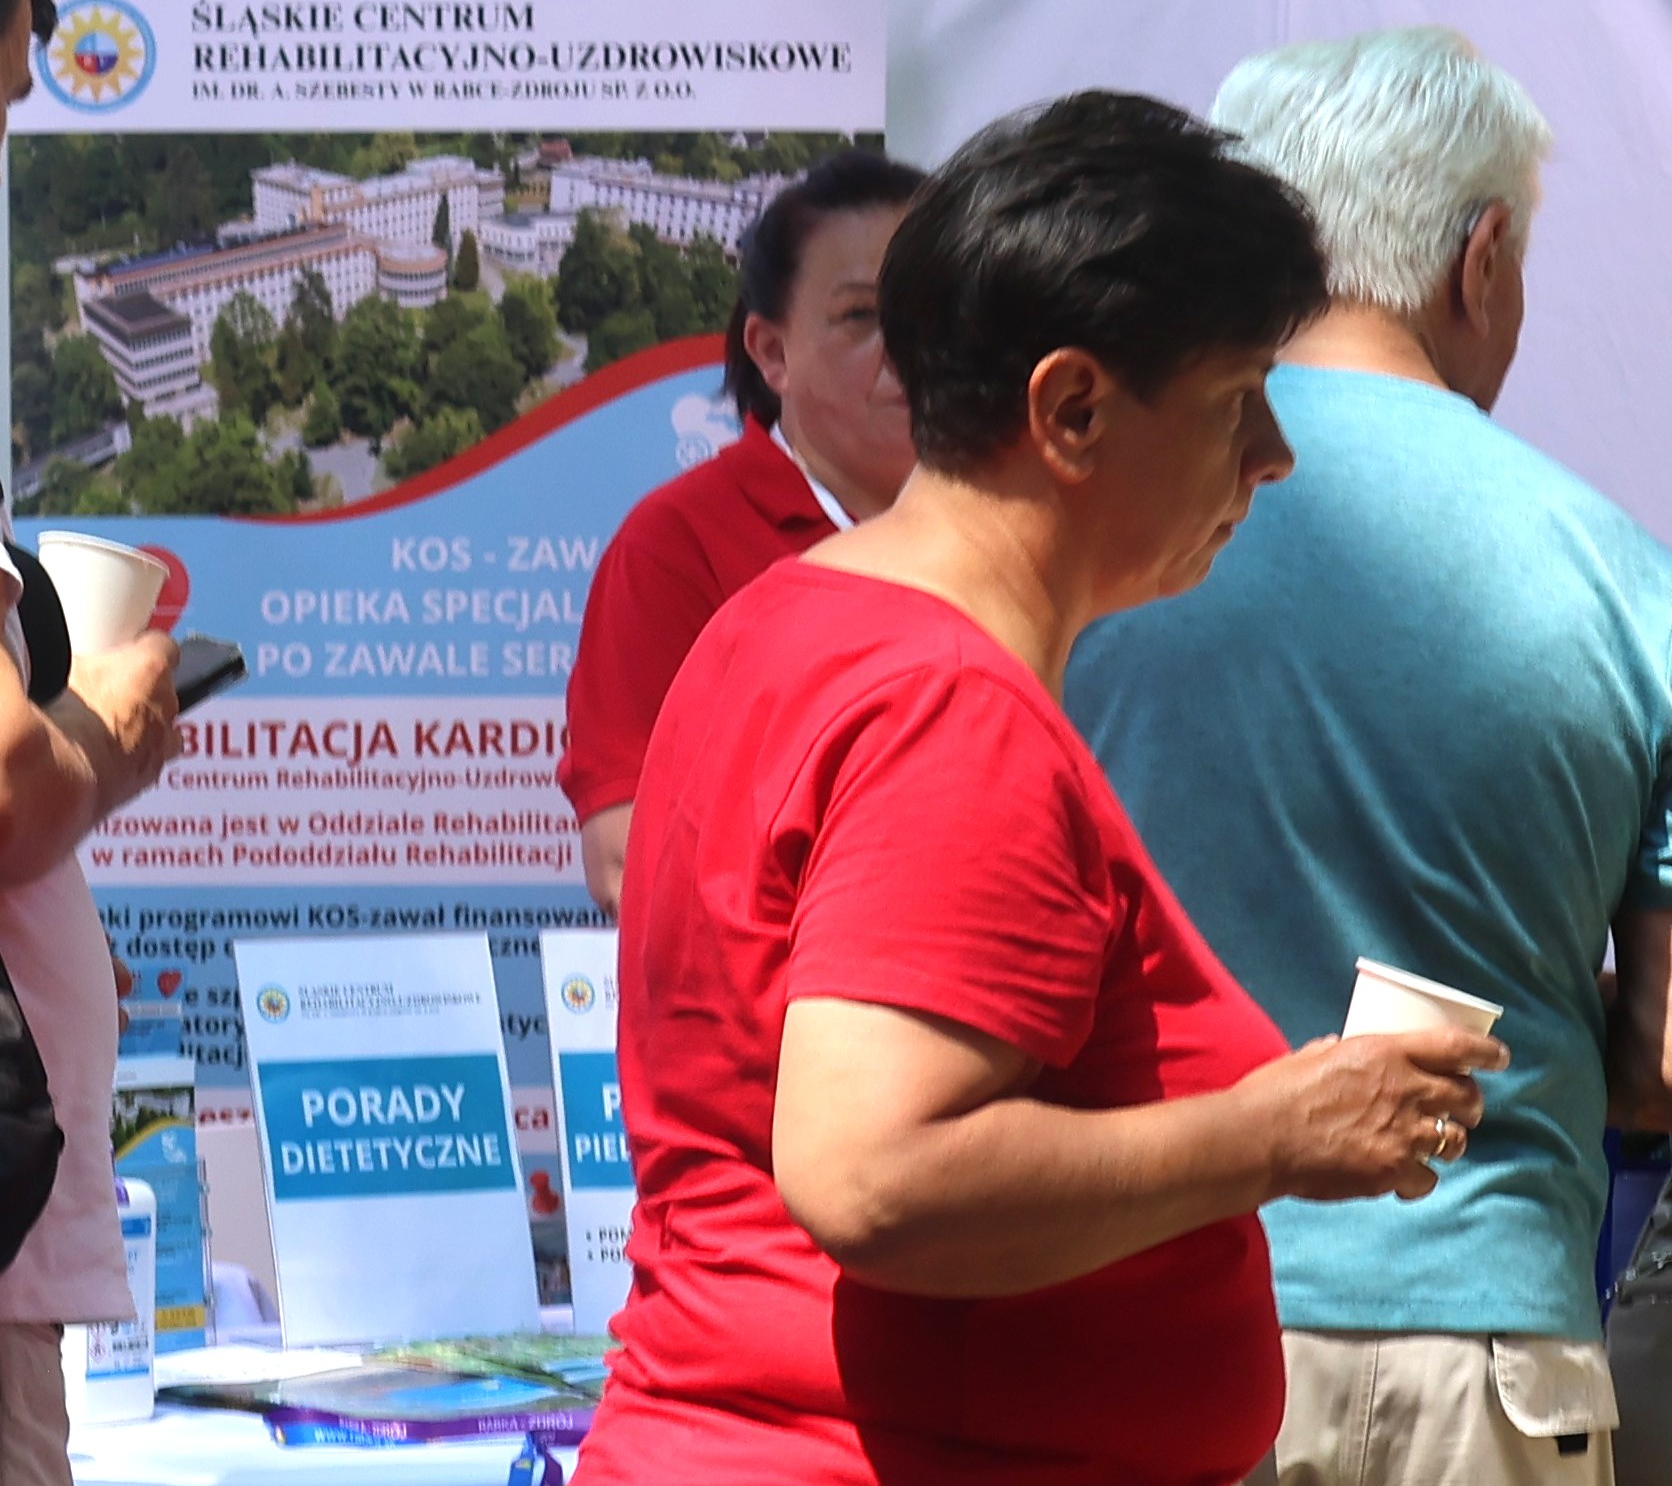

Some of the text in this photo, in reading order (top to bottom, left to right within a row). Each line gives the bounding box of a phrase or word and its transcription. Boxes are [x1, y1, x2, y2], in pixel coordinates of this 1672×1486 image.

[353, 2, 534, 33] CENTRUM
[192, 41, 852, 73] REHABILITACYJNO-UZDROWISKOWE
[391, 537, 472, 572] KOS
[506, 537, 599, 572] ZAW
[260, 589, 580, 632] OPIEKA SPECJAL
[256, 641, 573, 678] PO ZAWALE SER
[173, 720, 398, 768] BILITACJA
[167, 768, 270, 790] Centrum
[220, 811, 270, 842] jest
[278, 817, 300, 836] w
[308, 811, 425, 836] Oddziale
[91, 848, 114, 868] w
[122, 843, 224, 868] ramach
[406, 841, 573, 872] Rehabilitacji
[138, 905, 300, 934] programowi
[125, 933, 216, 964] dostęp
[301, 1082, 466, 1129] PORADY
[280, 1131, 503, 1176] DIETETYCZNE
